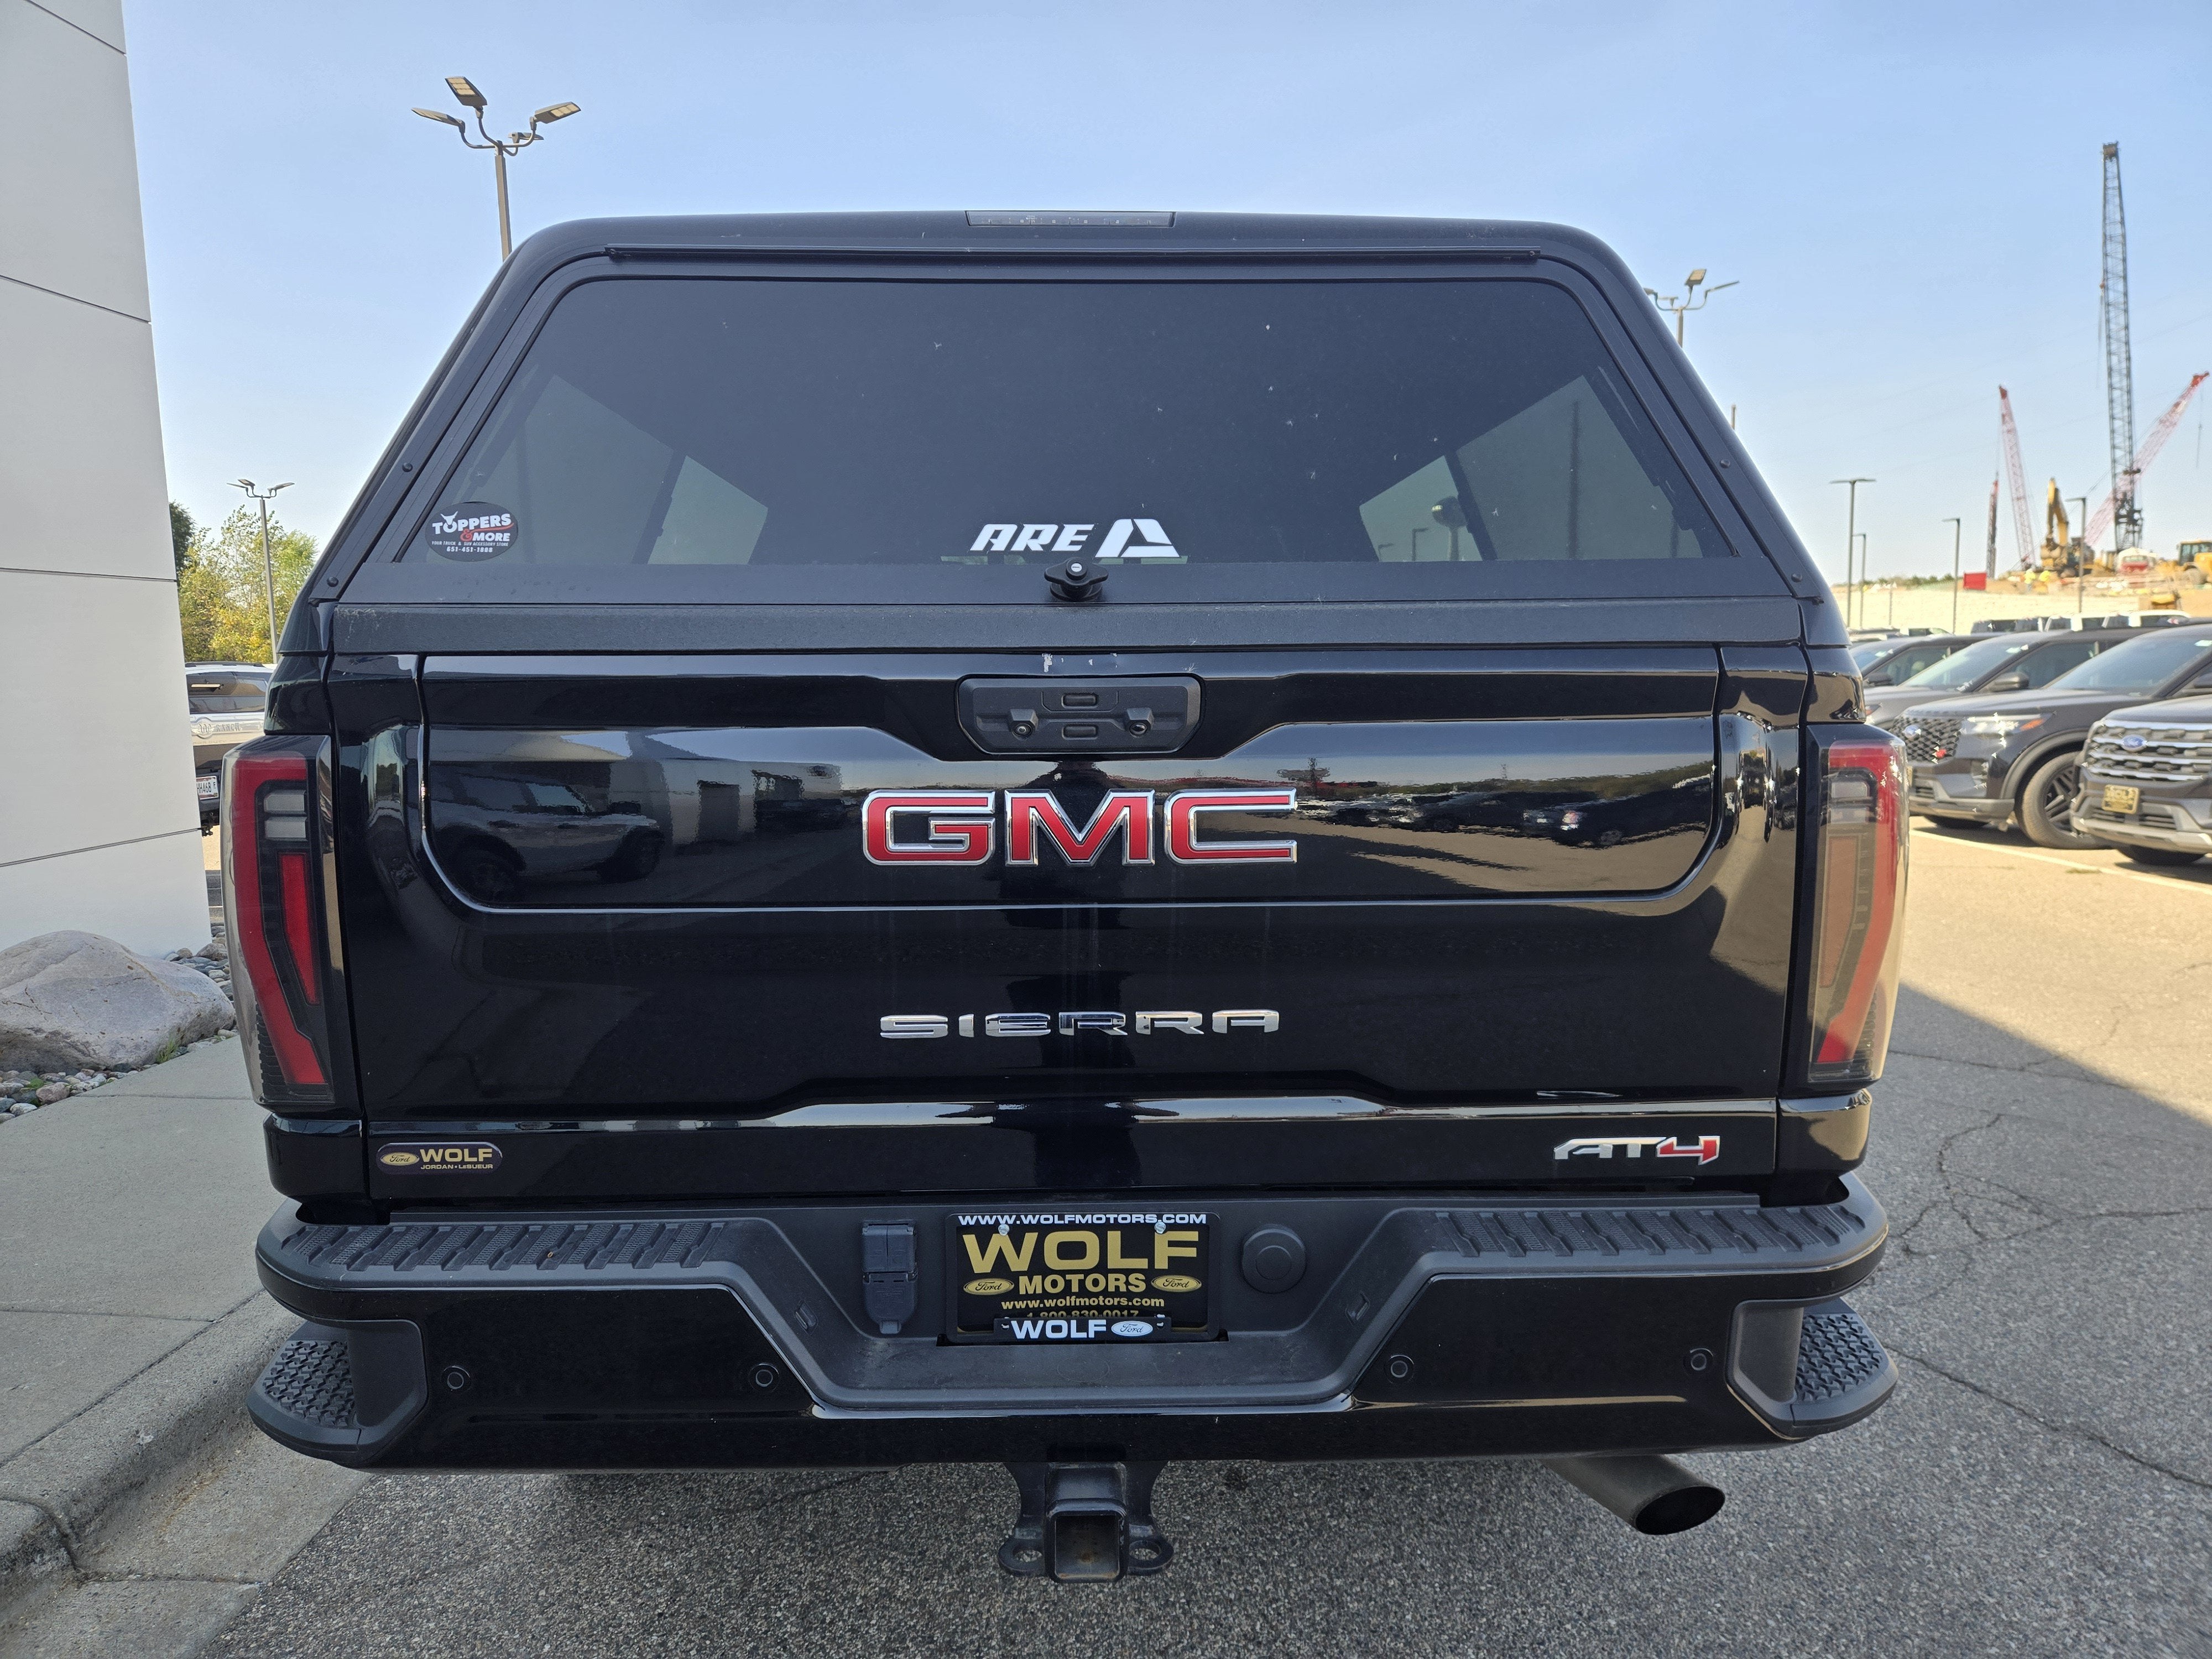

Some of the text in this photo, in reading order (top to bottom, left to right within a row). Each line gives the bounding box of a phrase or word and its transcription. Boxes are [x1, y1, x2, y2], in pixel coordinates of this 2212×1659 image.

[432, 513, 512, 535] TOPPERS
[472, 533, 510, 541] MORE
[970, 524, 1094, 551] ARE
[216, 723, 241, 732] RANCH
[862, 788, 1297, 867] GMC
[880, 1009, 1280, 1039] SIERRA
[389, 1149, 492, 1162] Ford WOLF
[1554, 1136, 1720, 1165] AT4
[958, 1214, 1207, 1225] WWW.WOLFMOTORS.COM
[962, 1230, 1199, 1274] WOLF
[975, 1273, 1190, 1295] Ford MOTORS Ford
[1001, 1296, 1165, 1310] www.wolfmotors.com
[1027, 1310, 1139, 1318] 1800-830-0017
[1011, 1319, 1144, 1339] WOLF Ford
